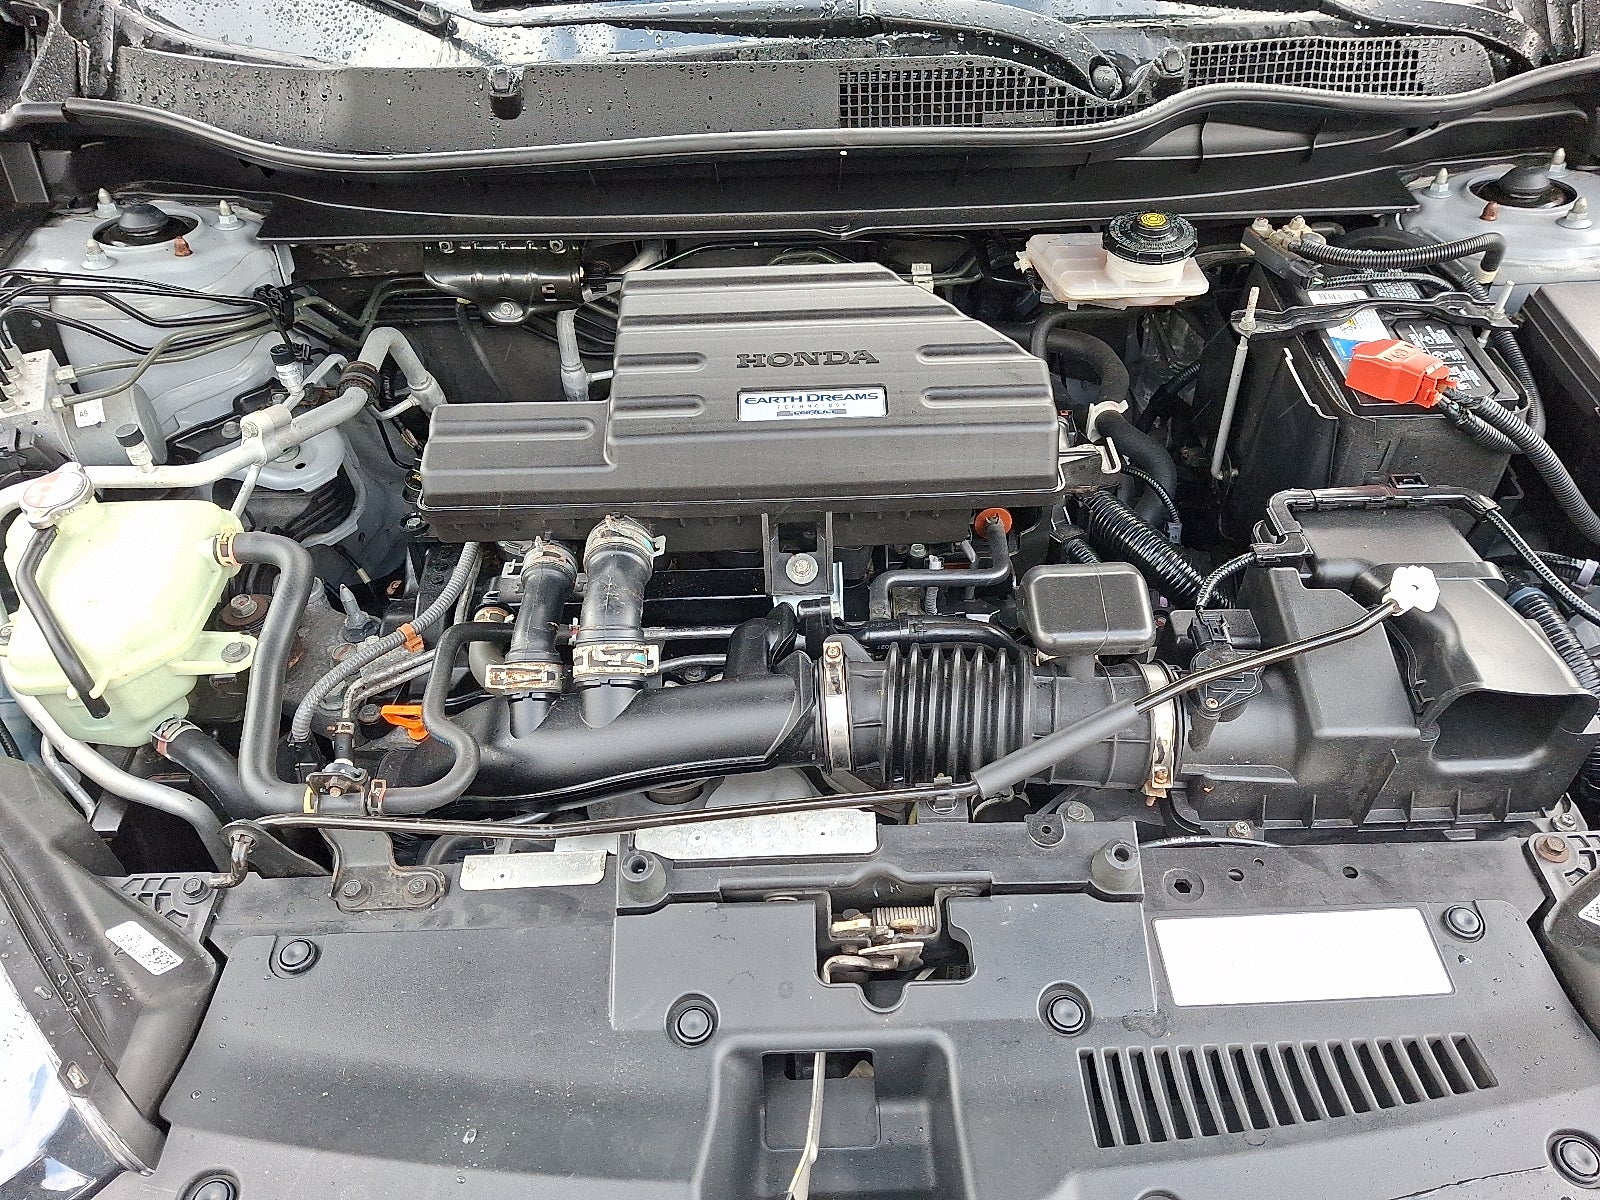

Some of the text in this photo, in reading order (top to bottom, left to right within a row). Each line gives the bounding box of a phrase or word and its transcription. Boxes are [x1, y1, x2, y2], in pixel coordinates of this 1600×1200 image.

[736, 350, 880, 368] HONDA
[744, 392, 879, 405] EARTH DREAMS
